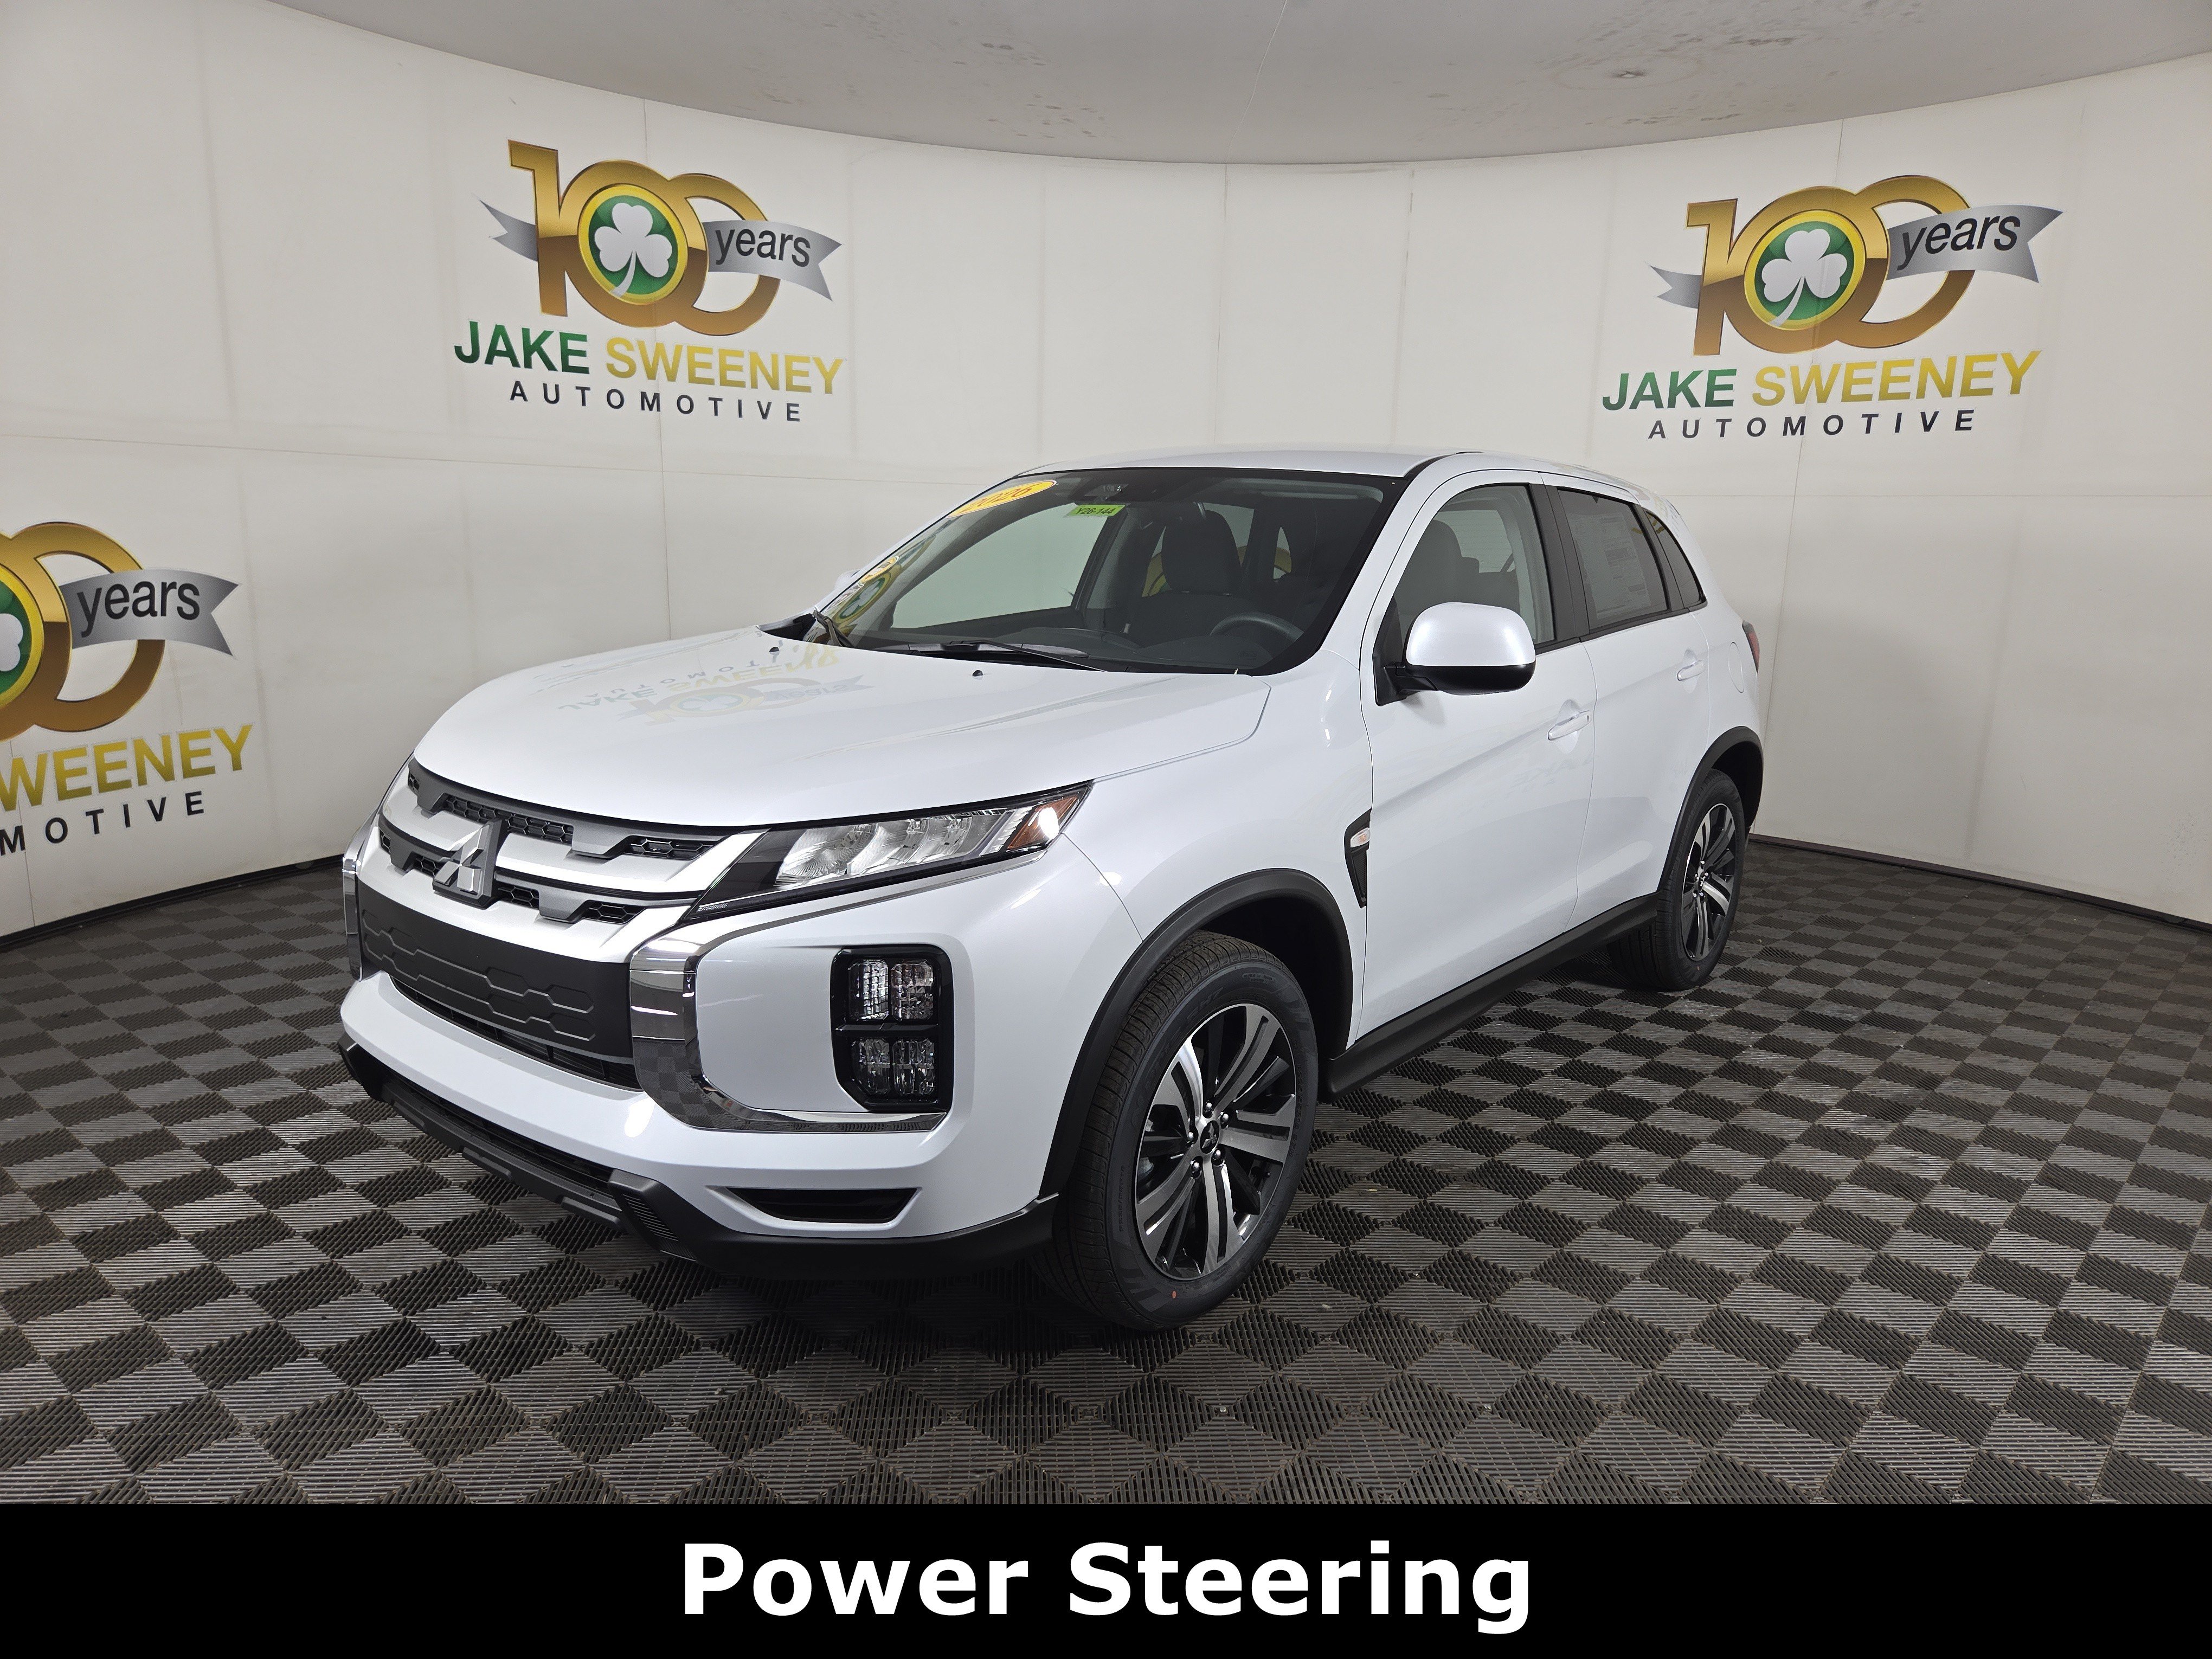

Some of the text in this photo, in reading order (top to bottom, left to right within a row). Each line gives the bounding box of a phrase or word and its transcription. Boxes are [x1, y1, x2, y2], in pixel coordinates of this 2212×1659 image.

[507, 139, 811, 337] 100 years
[1686, 175, 2021, 356] 100 years
[454, 321, 845, 395] JAKE SWEENEY
[1603, 350, 2042, 410] JAKE SWEENEY
[510, 381, 800, 421] AUTOMOTIVE
[1648, 409, 1975, 440] AUTOMOTIVE
[77, 581, 201, 637] years
